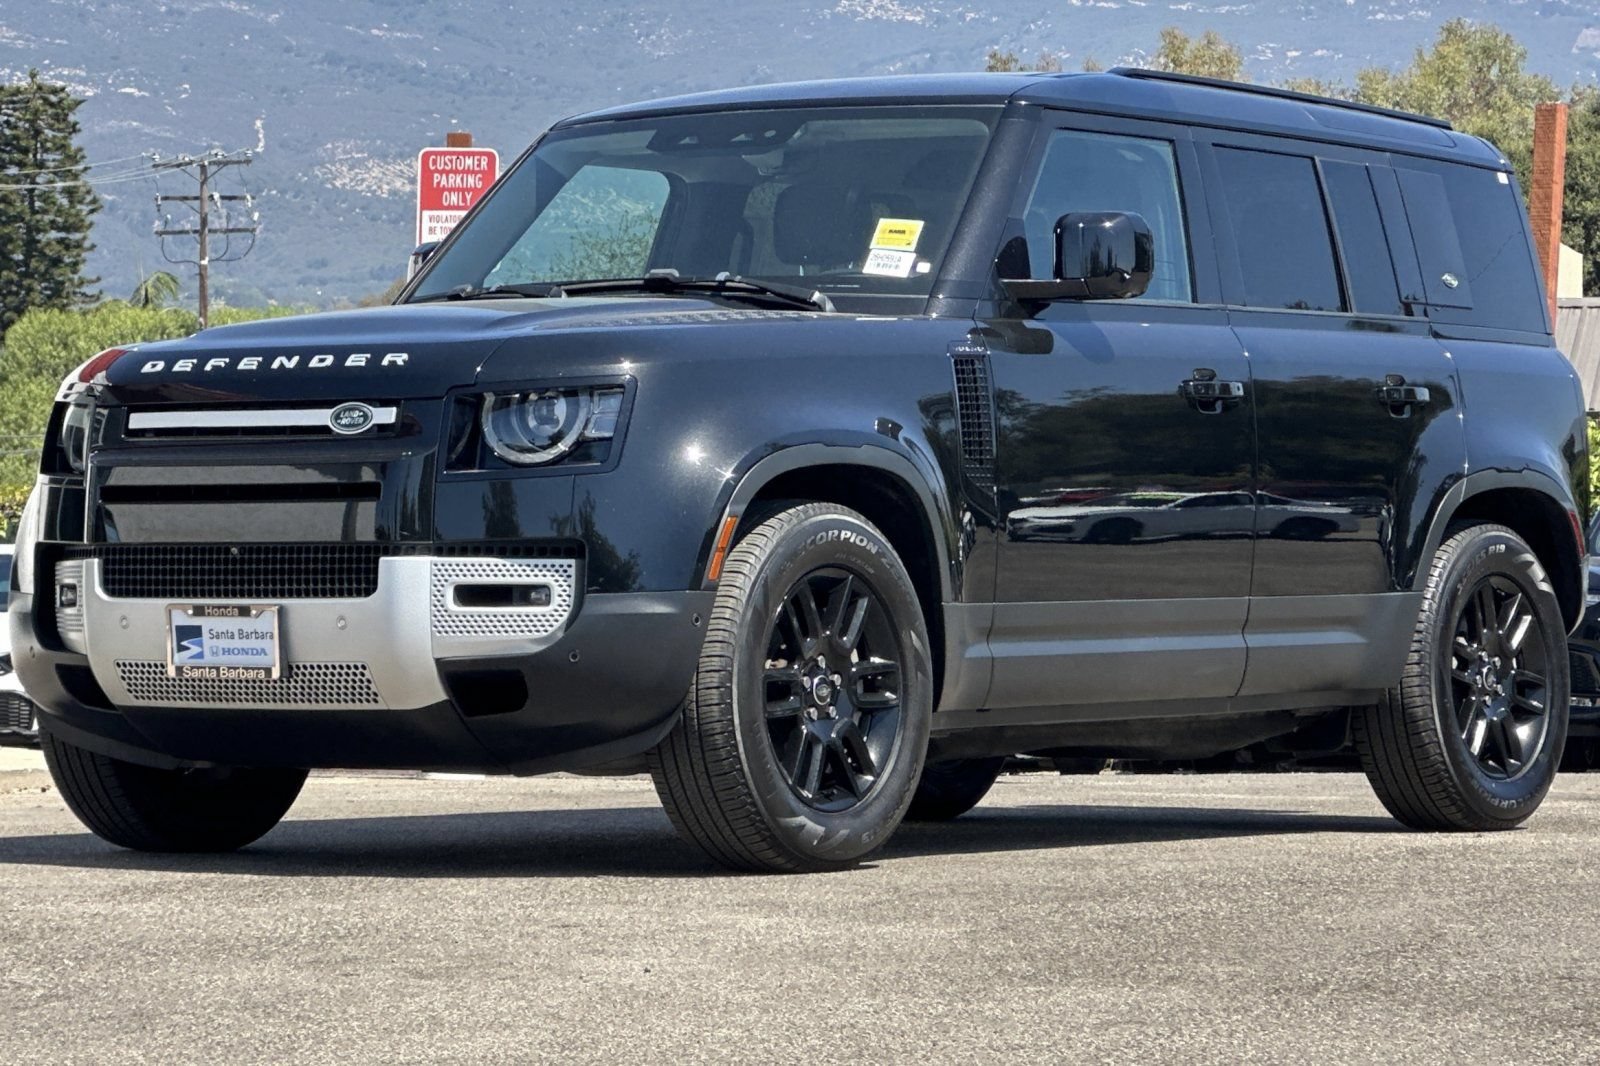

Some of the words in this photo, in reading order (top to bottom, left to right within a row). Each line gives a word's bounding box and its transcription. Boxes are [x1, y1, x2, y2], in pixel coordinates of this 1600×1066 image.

[429, 155, 488, 171] CUSTOMER
[433, 173, 482, 188] PARKING
[442, 191, 473, 206] ONLY
[428, 226, 437, 235] BE
[140, 353, 409, 373] DEFENDER
[340, 410, 359, 418] LAND
[340, 417, 364, 425] ROVER
[800, 529, 879, 556] SCORPION
[204, 606, 239, 616] Honda
[208, 628, 235, 640] Santa
[238, 628, 274, 640] Barbara
[221, 647, 268, 656] HONDA
[182, 666, 217, 678] Santa
[220, 666, 265, 679] Barbara
